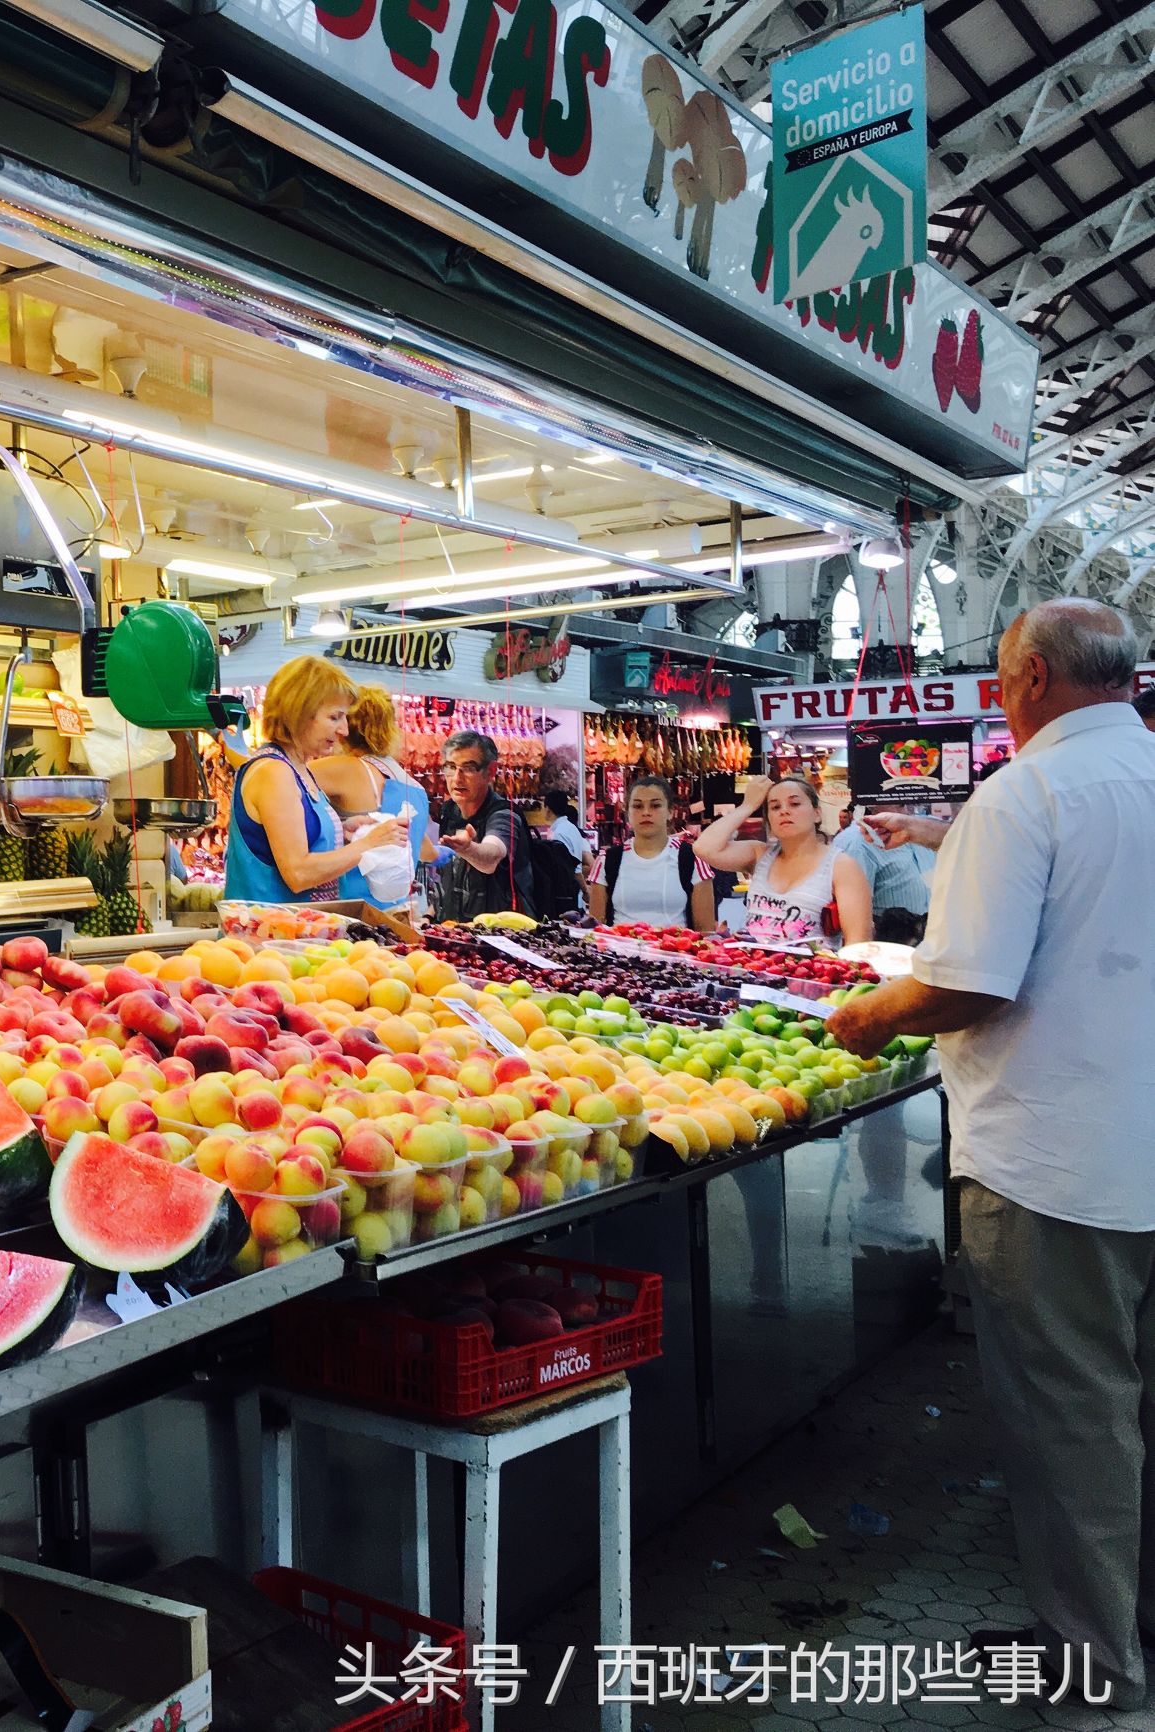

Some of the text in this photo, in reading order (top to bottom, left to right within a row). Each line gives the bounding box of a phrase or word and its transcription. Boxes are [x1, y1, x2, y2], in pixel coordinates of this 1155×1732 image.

[781, 41, 917, 113] Servicio a
[785, 82, 915, 149] domicilio
[812, 120, 899, 161] ESPAÑA Y EUROPA
[759, 682, 955, 722] FRUTAS
[539, 1352, 592, 1385] MARCOS
[554, 1346, 578, 1361] Fruits
